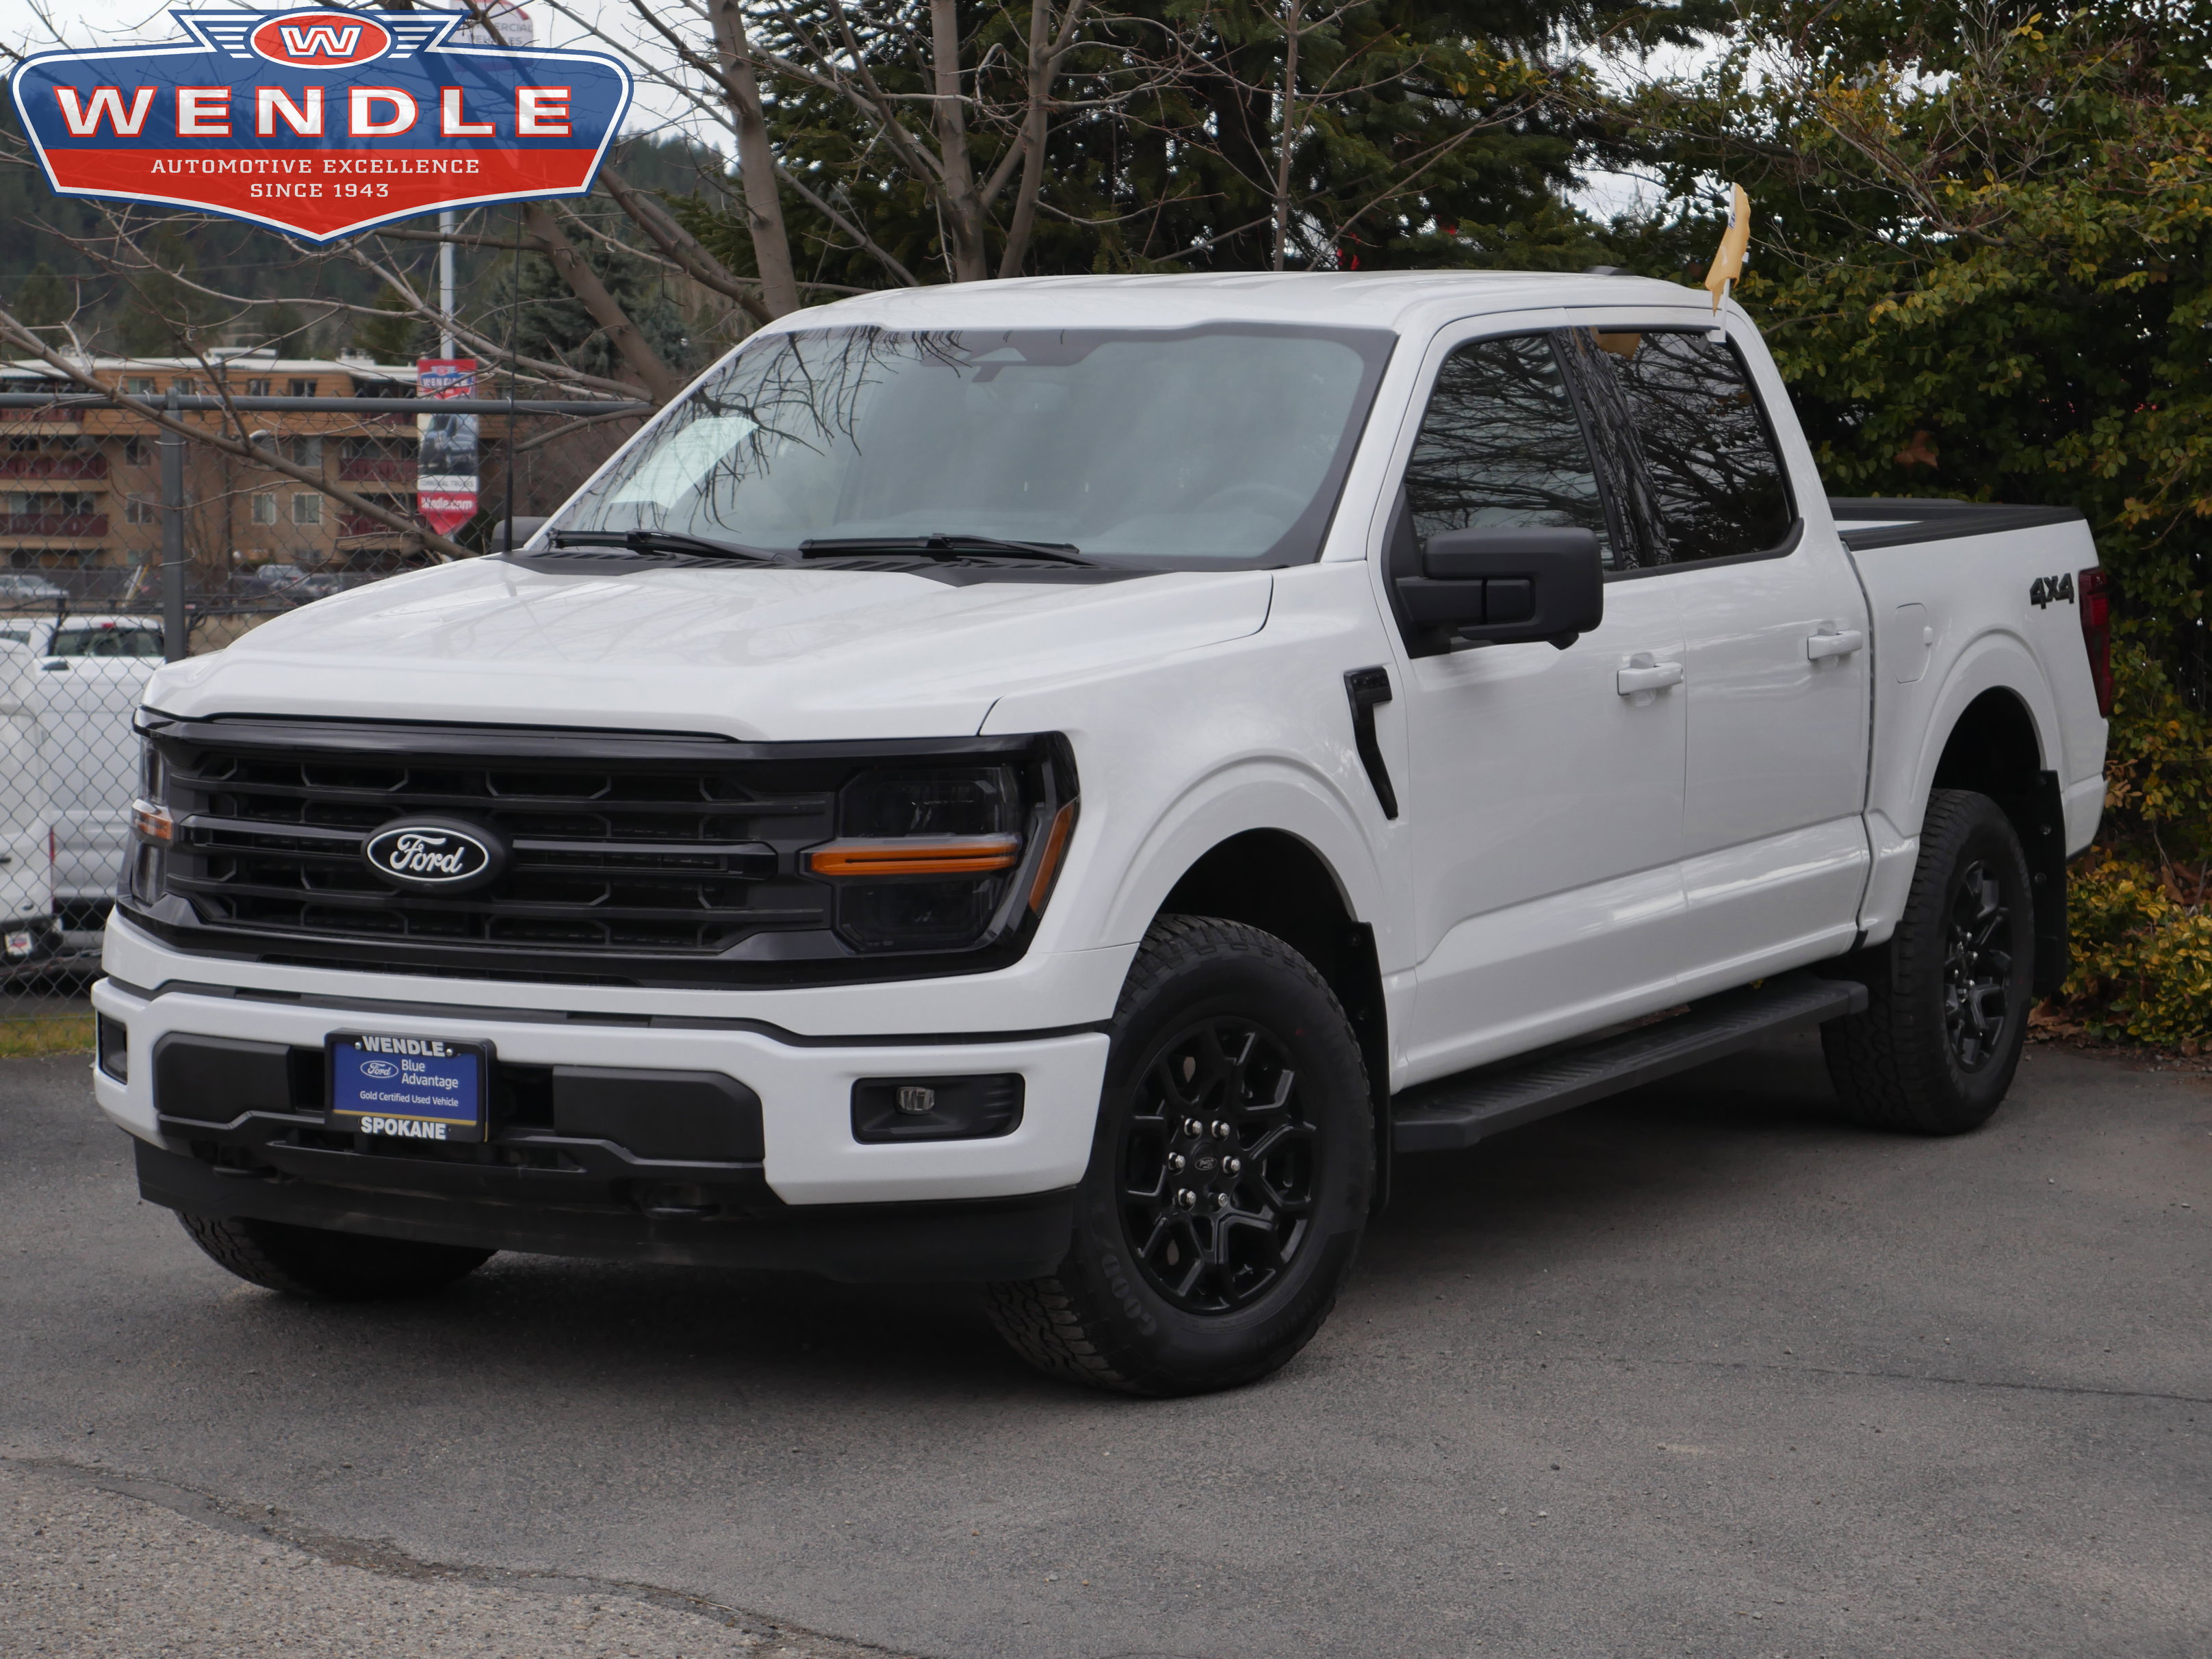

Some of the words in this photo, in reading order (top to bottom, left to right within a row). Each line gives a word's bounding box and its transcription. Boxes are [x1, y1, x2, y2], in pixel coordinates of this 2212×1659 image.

[389, 834, 465, 873] Ford
[362, 1036, 445, 1057] WENDLE
[368, 1062, 391, 1076] Ford
[402, 1059, 425, 1072] Blue
[401, 1073, 459, 1090] Advantage
[360, 1090, 377, 1101] Gold
[378, 1092, 410, 1103] Certified
[411, 1095, 430, 1105] Used
[432, 1096, 459, 1107] Vehicle
[361, 1116, 446, 1140] SPOKANE
